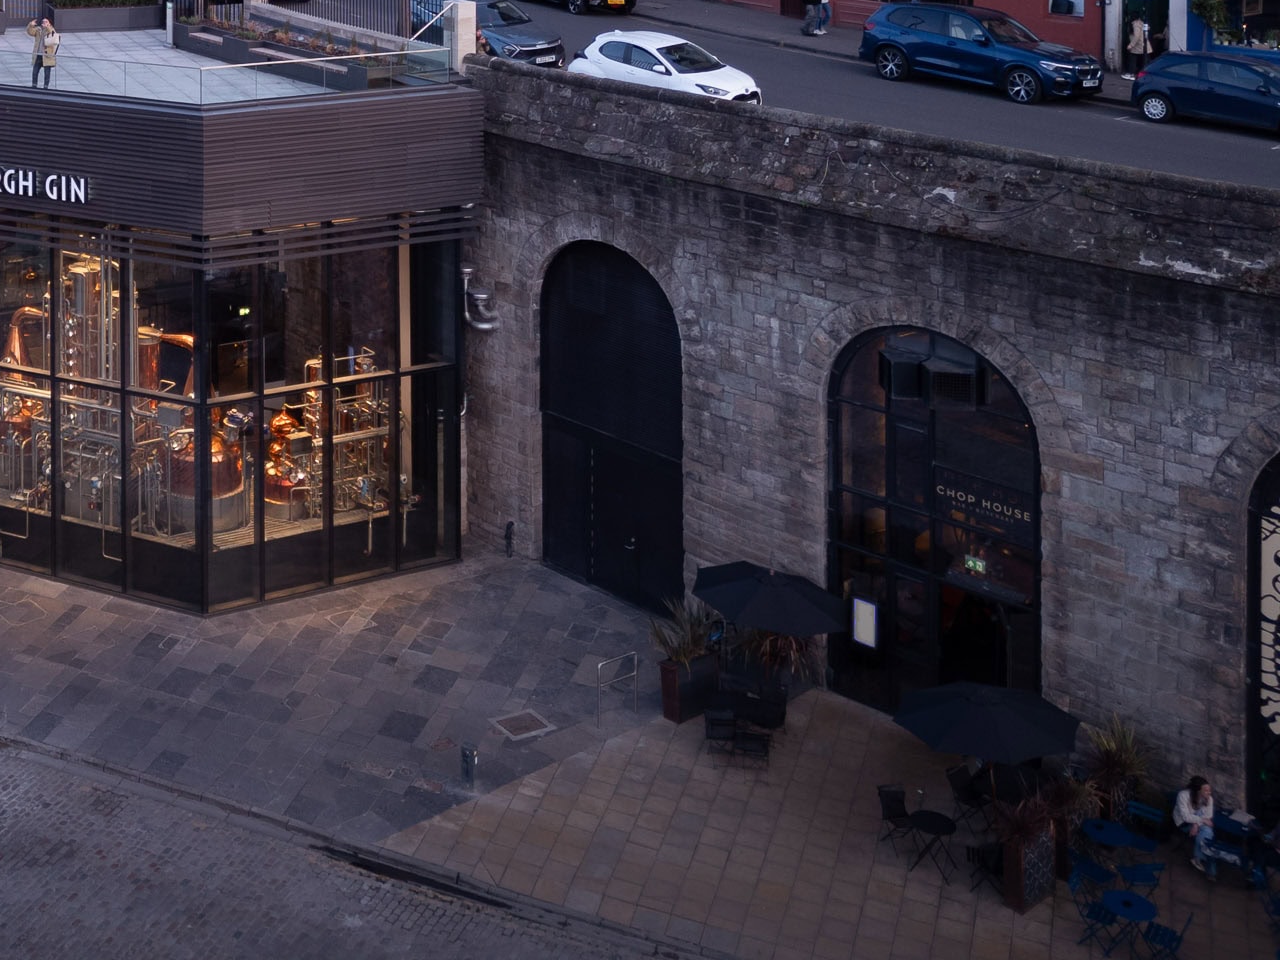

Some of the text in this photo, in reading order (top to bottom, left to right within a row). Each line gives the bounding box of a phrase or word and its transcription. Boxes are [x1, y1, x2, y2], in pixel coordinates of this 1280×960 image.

[45, 174, 86, 204] GIN
[936, 485, 1031, 522] CHOP HOUSE
